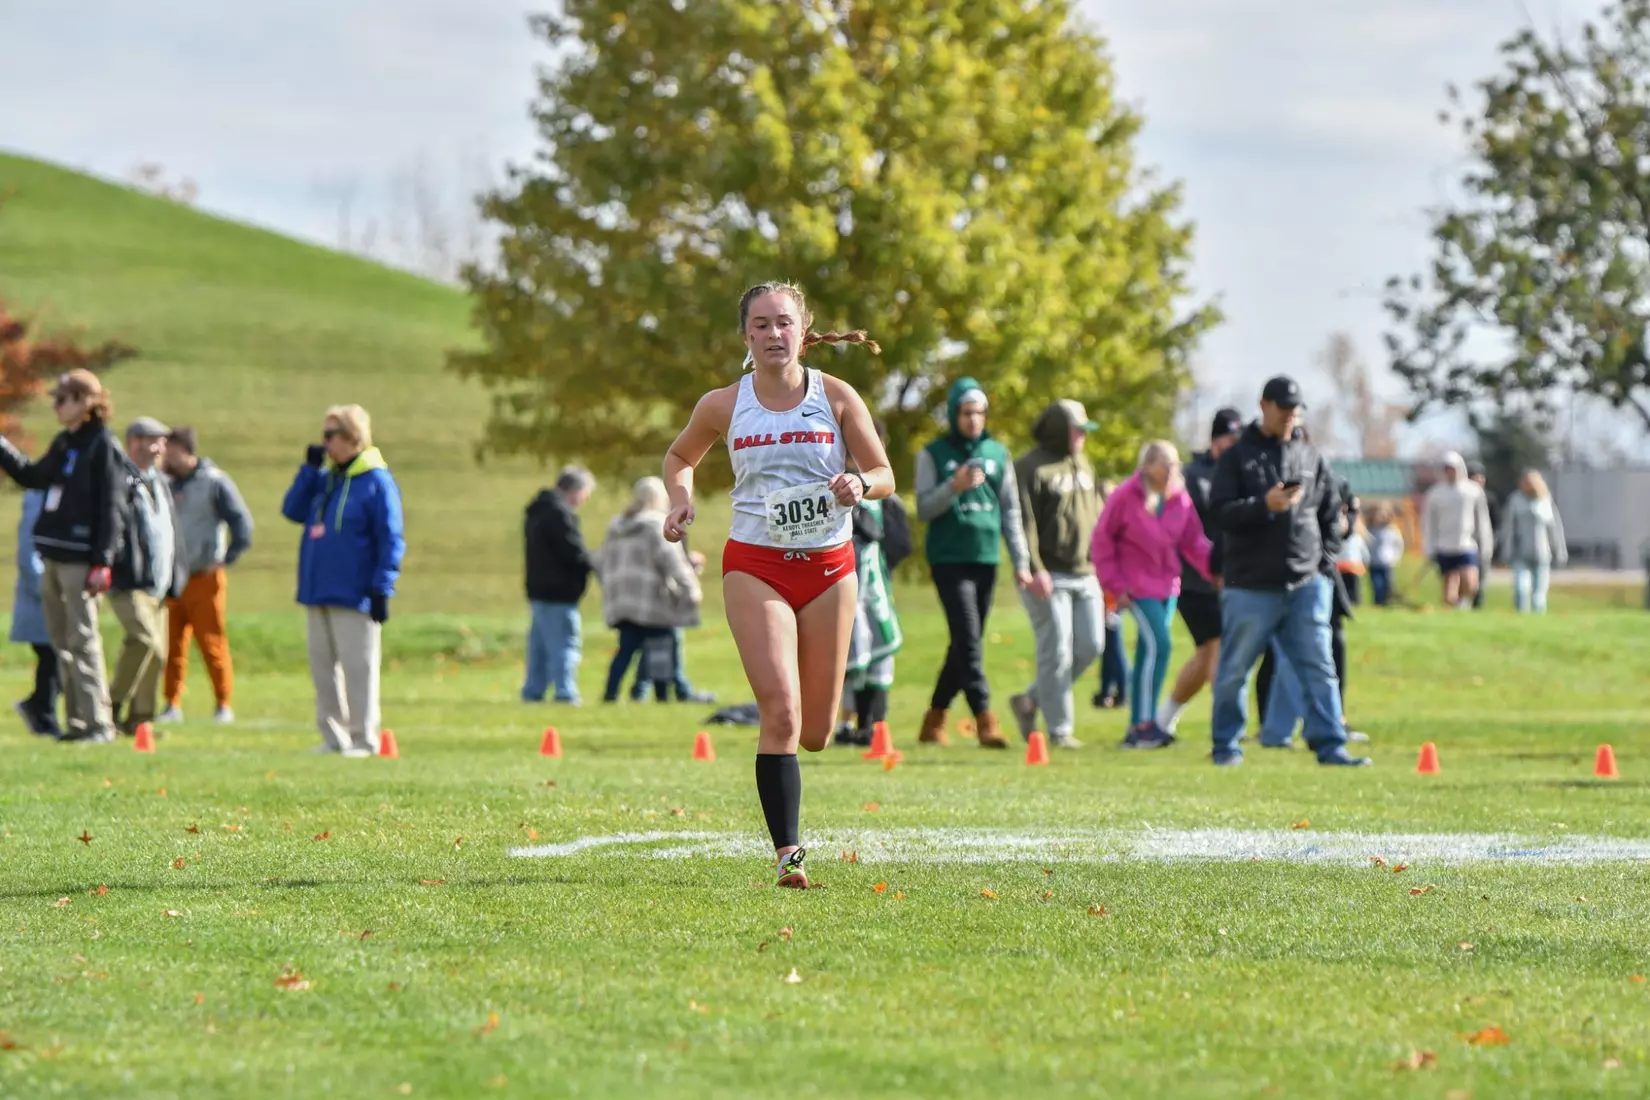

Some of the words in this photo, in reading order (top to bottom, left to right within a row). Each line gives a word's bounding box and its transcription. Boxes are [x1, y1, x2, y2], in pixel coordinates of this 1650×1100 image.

[734, 433, 776, 451] BALL
[779, 431, 835, 444] STATE
[774, 496, 829, 526] 3034
[791, 529, 803, 537] BALL
[804, 527, 817, 535] STATE
